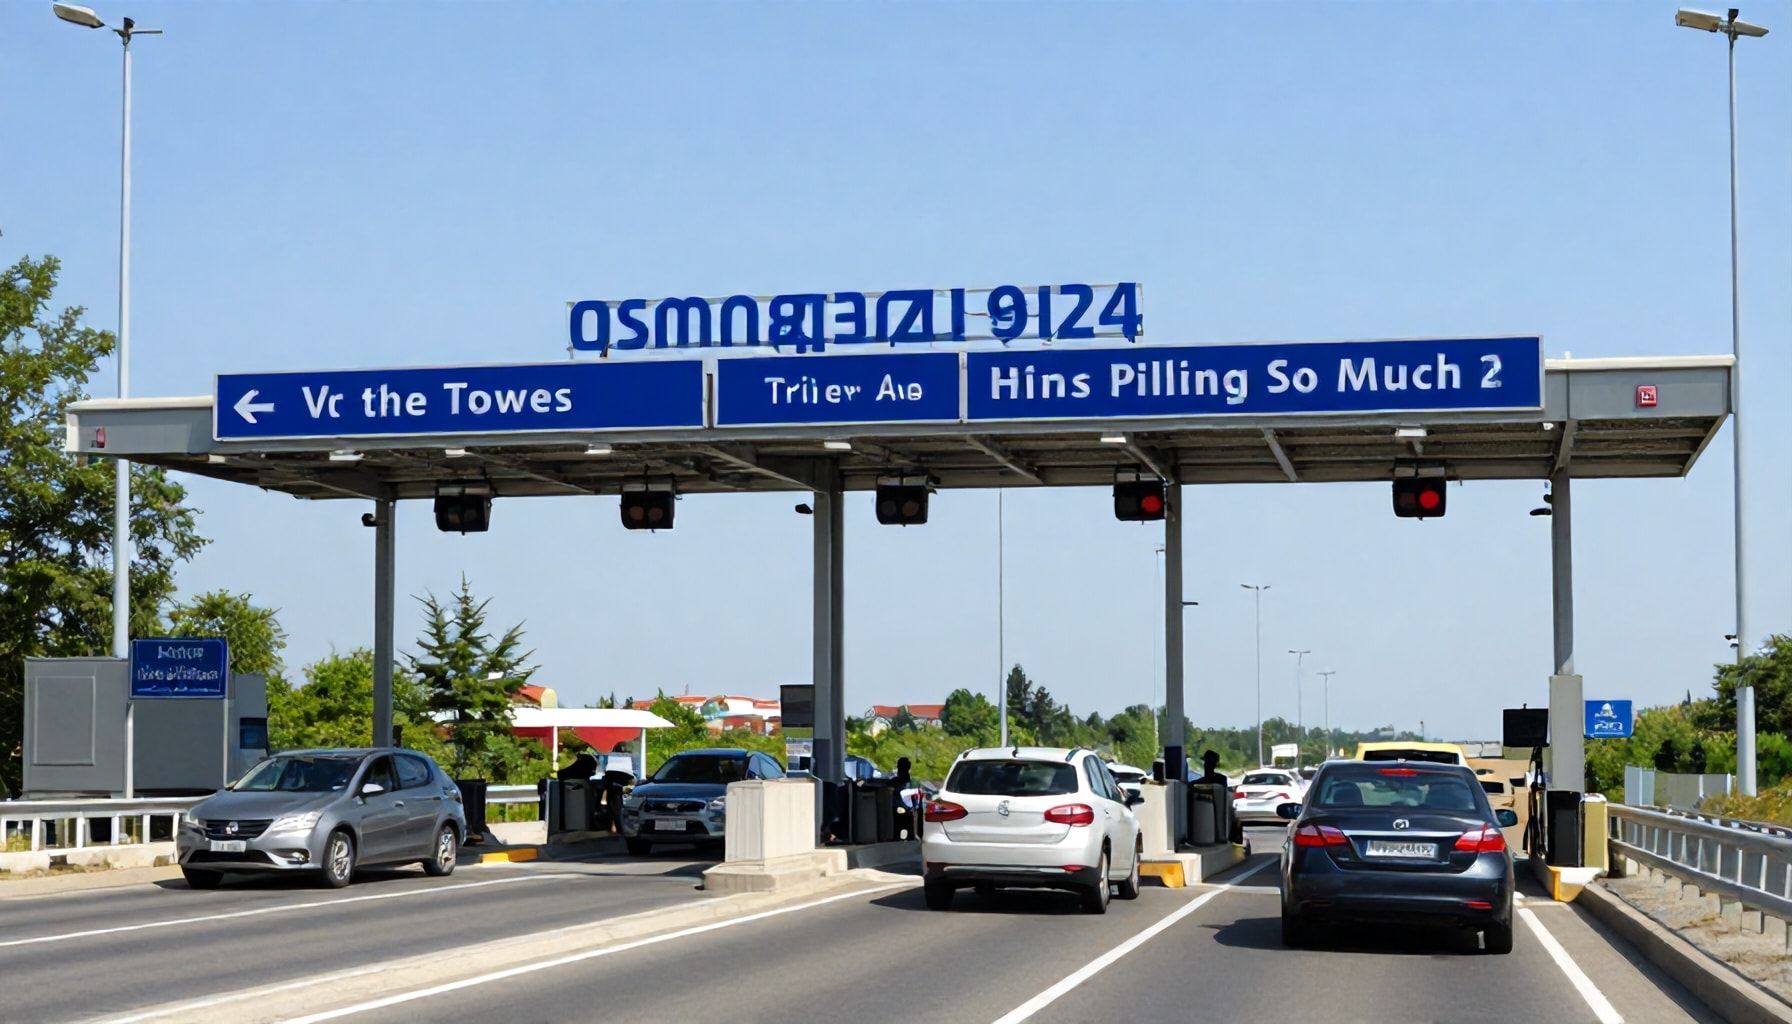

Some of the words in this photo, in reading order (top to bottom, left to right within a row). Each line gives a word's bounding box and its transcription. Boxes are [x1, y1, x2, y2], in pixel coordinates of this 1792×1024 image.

[361, 384, 428, 418] the
[443, 382, 573, 416] Towes
[991, 365, 1092, 401] Hins
[1110, 359, 1248, 406] Pilling
[1267, 359, 1319, 395] So
[1337, 353, 1462, 393] Much
[1480, 354, 1503, 390] 2
